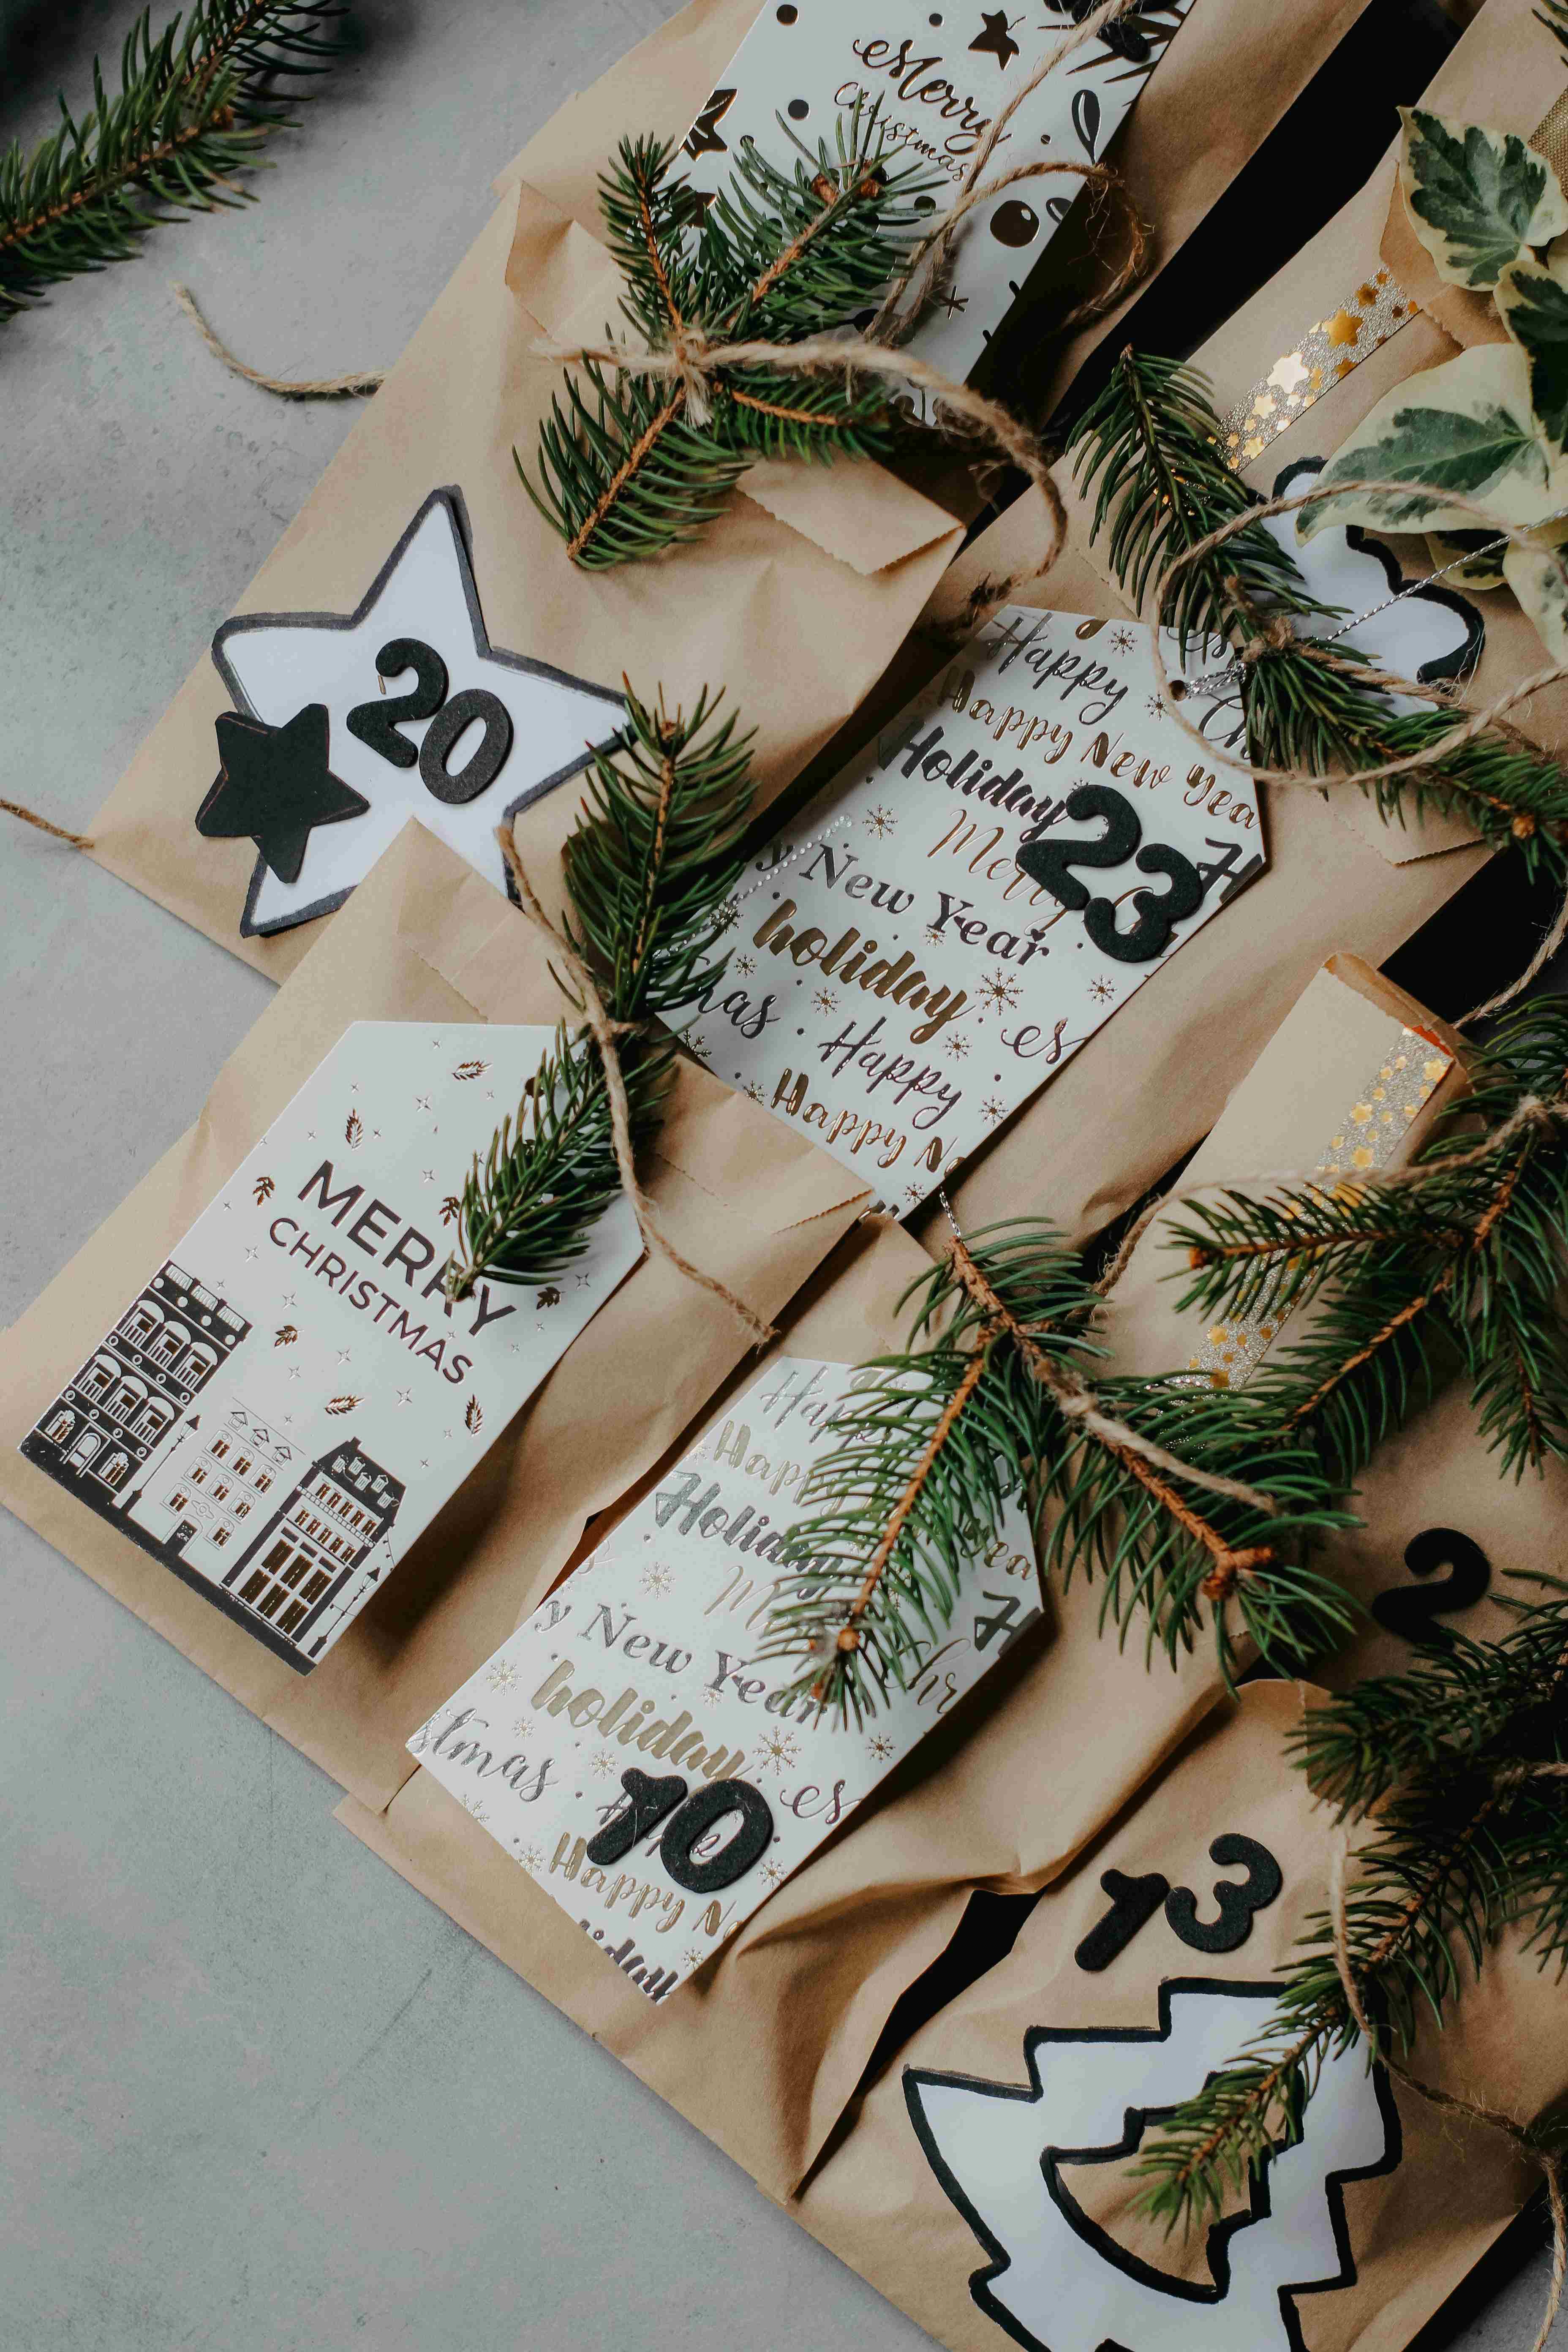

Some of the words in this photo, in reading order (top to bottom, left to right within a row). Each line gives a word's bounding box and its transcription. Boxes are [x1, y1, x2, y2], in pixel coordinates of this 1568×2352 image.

[346, 638, 514, 804] 20
[936, 665, 1074, 764] Happy
[1081, 732, 1173, 789] New
[988, 612, 1128, 725] Happy
[878, 718, 1069, 844] Holiday
[798, 844, 914, 915] New
[927, 891, 1050, 965] Year
[1015, 784, 1203, 964] 23
[753, 898, 976, 1045] holiday
[770, 1068, 906, 1168] Happy
[817, 1016, 963, 1130] Happy
[270, 1217, 474, 1385] CHRISTMAS
[297, 1160, 517, 1337] MERRY
[535, 1600, 572, 1633] y
[577, 1603, 693, 1673] New
[1372, 1527, 1491, 1655] 2
[549, 1832, 686, 1933] Happy
[586, 1767, 774, 1894] 10
[1074, 1832, 1283, 1972] 13
